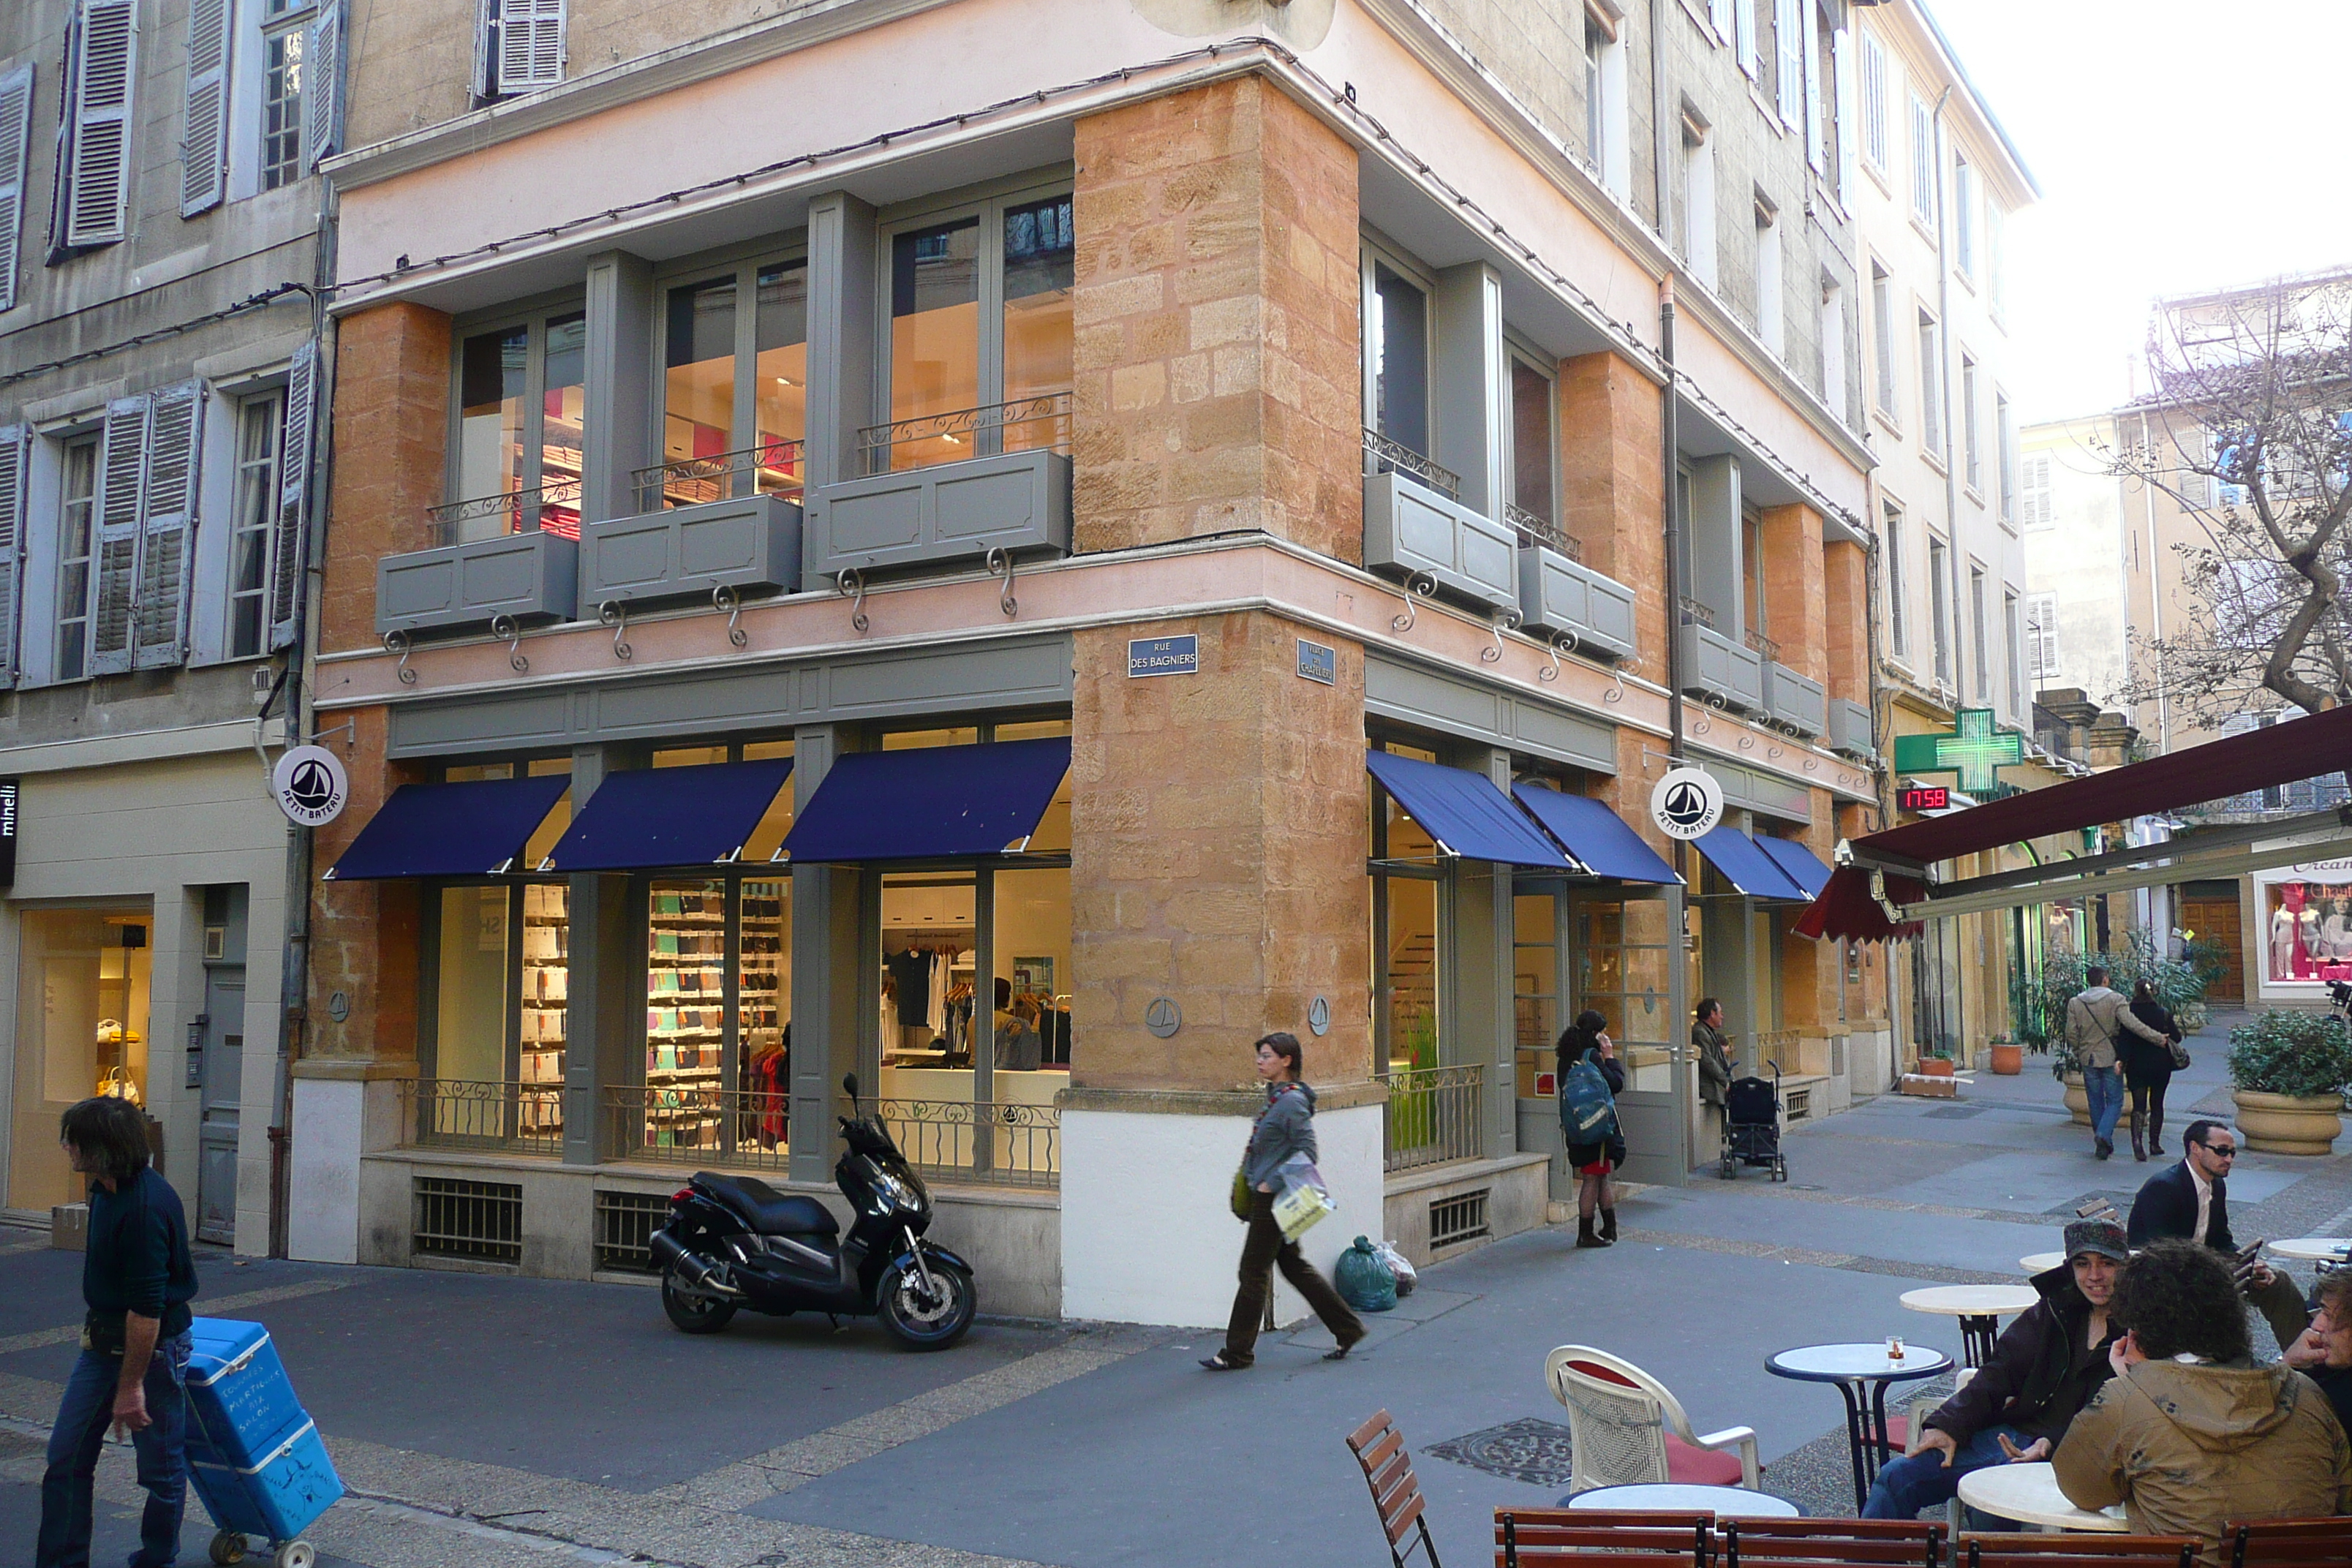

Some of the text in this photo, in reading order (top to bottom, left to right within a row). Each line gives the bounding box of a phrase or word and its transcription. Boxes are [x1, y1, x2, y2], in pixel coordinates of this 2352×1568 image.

[1154, 642, 1171, 652] RUE
[1131, 653, 1196, 668] DES BAGNIERS
[0, 785, 16, 837] minelli
[282, 790, 341, 819] PETIT BATEAU
[1657, 808, 1715, 834] PETIT BATEAU
